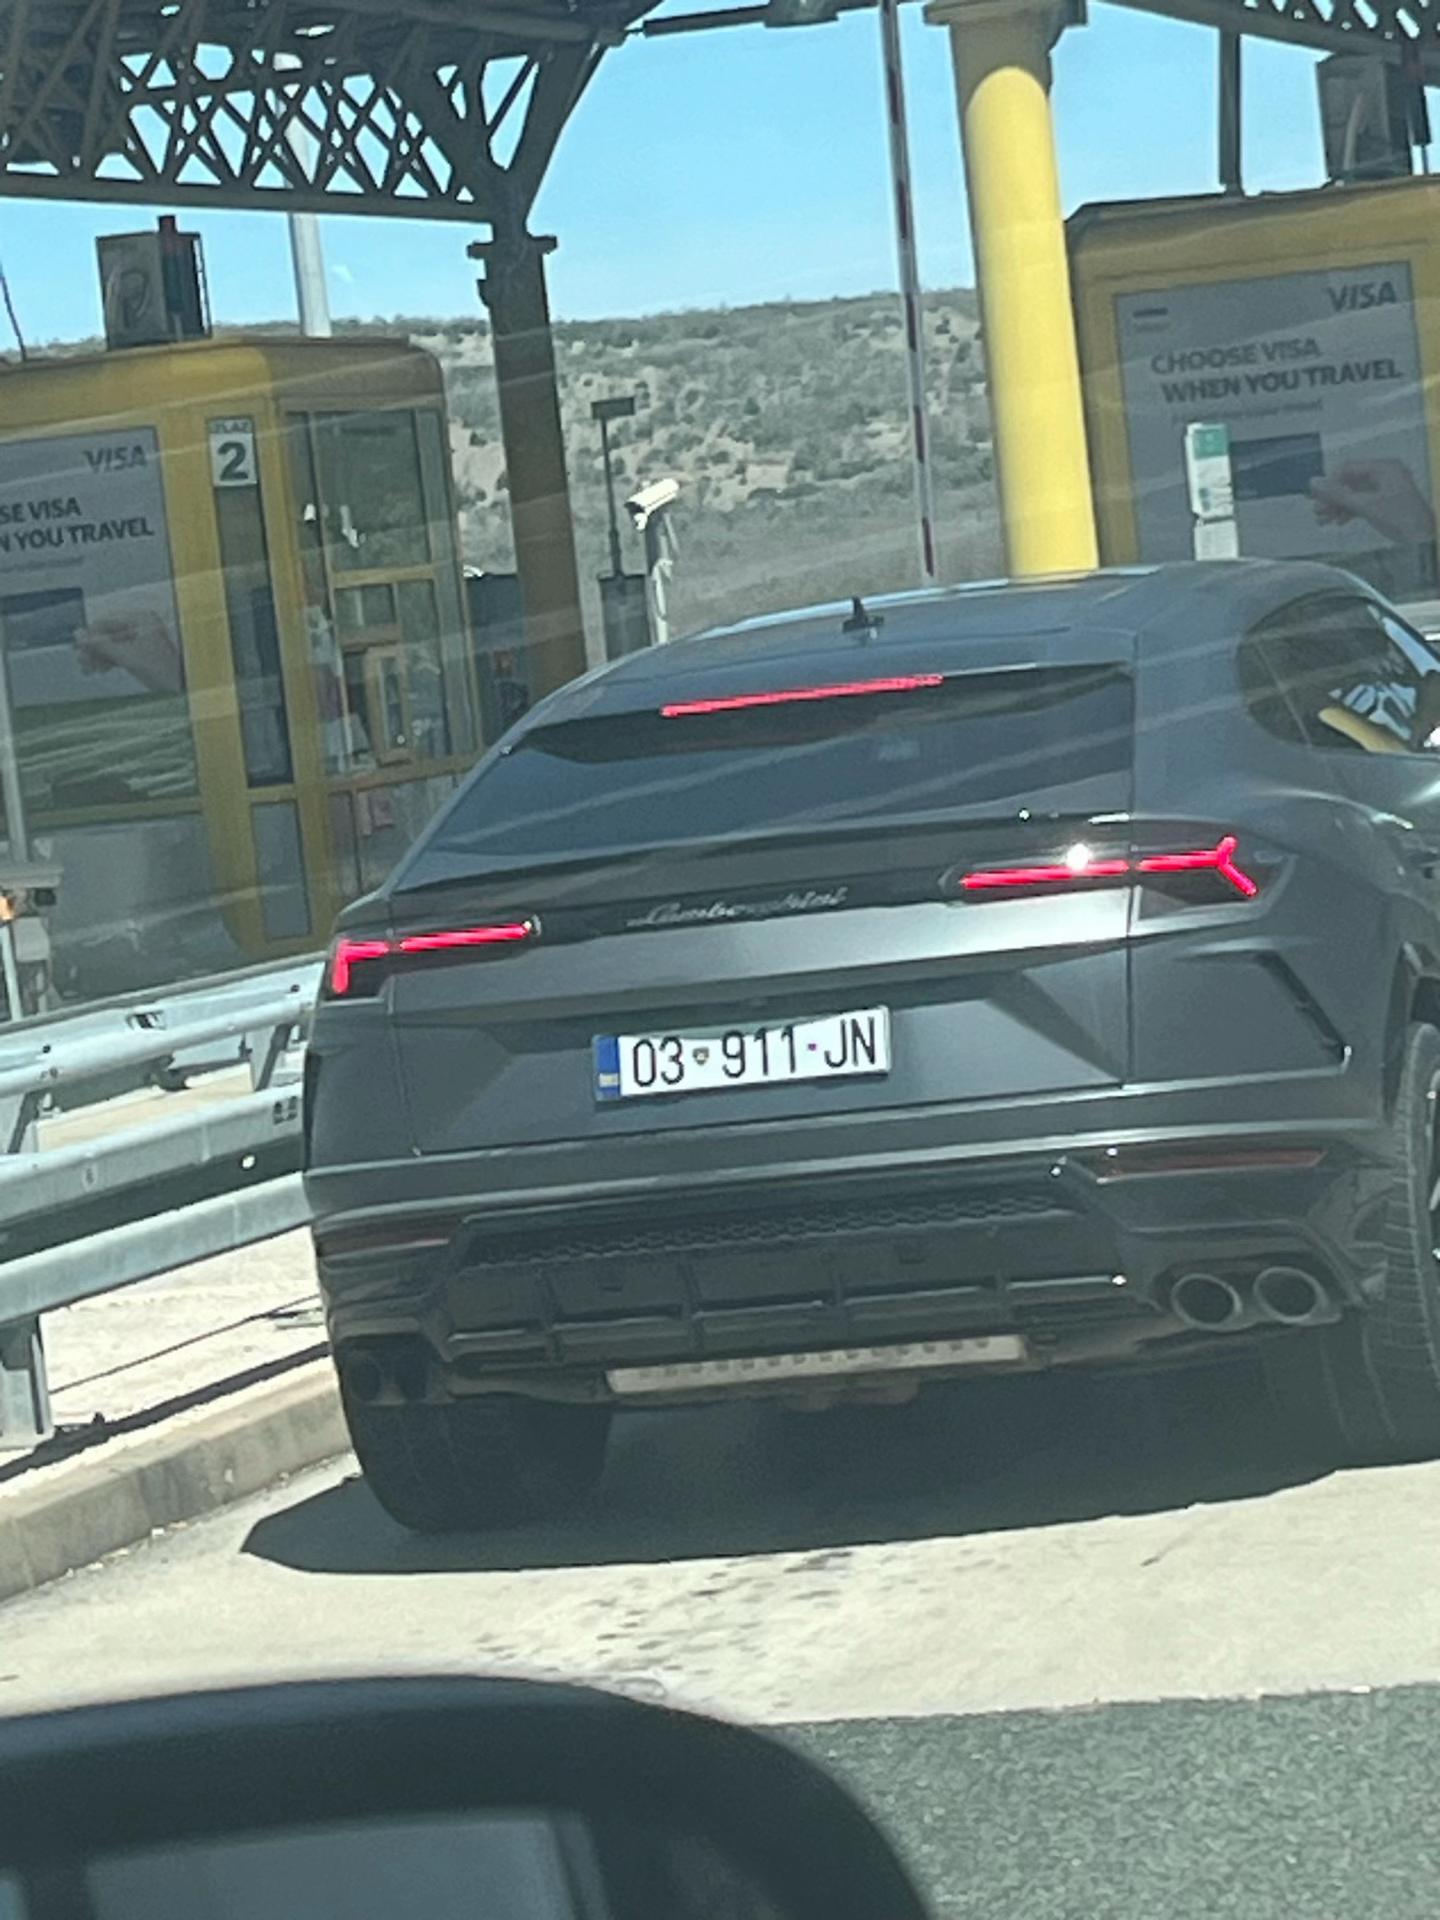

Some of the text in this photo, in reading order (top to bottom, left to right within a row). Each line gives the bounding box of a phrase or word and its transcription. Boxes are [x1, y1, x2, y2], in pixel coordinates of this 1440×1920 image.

[1326, 281, 1397, 312] VISA
[1152, 337, 1321, 375] CHOOSE VISA
[1161, 358, 1403, 404] WHEN YOU TRAVEL
[85, 445, 148, 473] VISA
[217, 441, 249, 481] 2
[28, 497, 81, 520] VISA
[14, 526, 64, 550] YOU
[66, 516, 154, 545] TRAVEL
[632, 1016, 876, 1088] 03 911 JN
